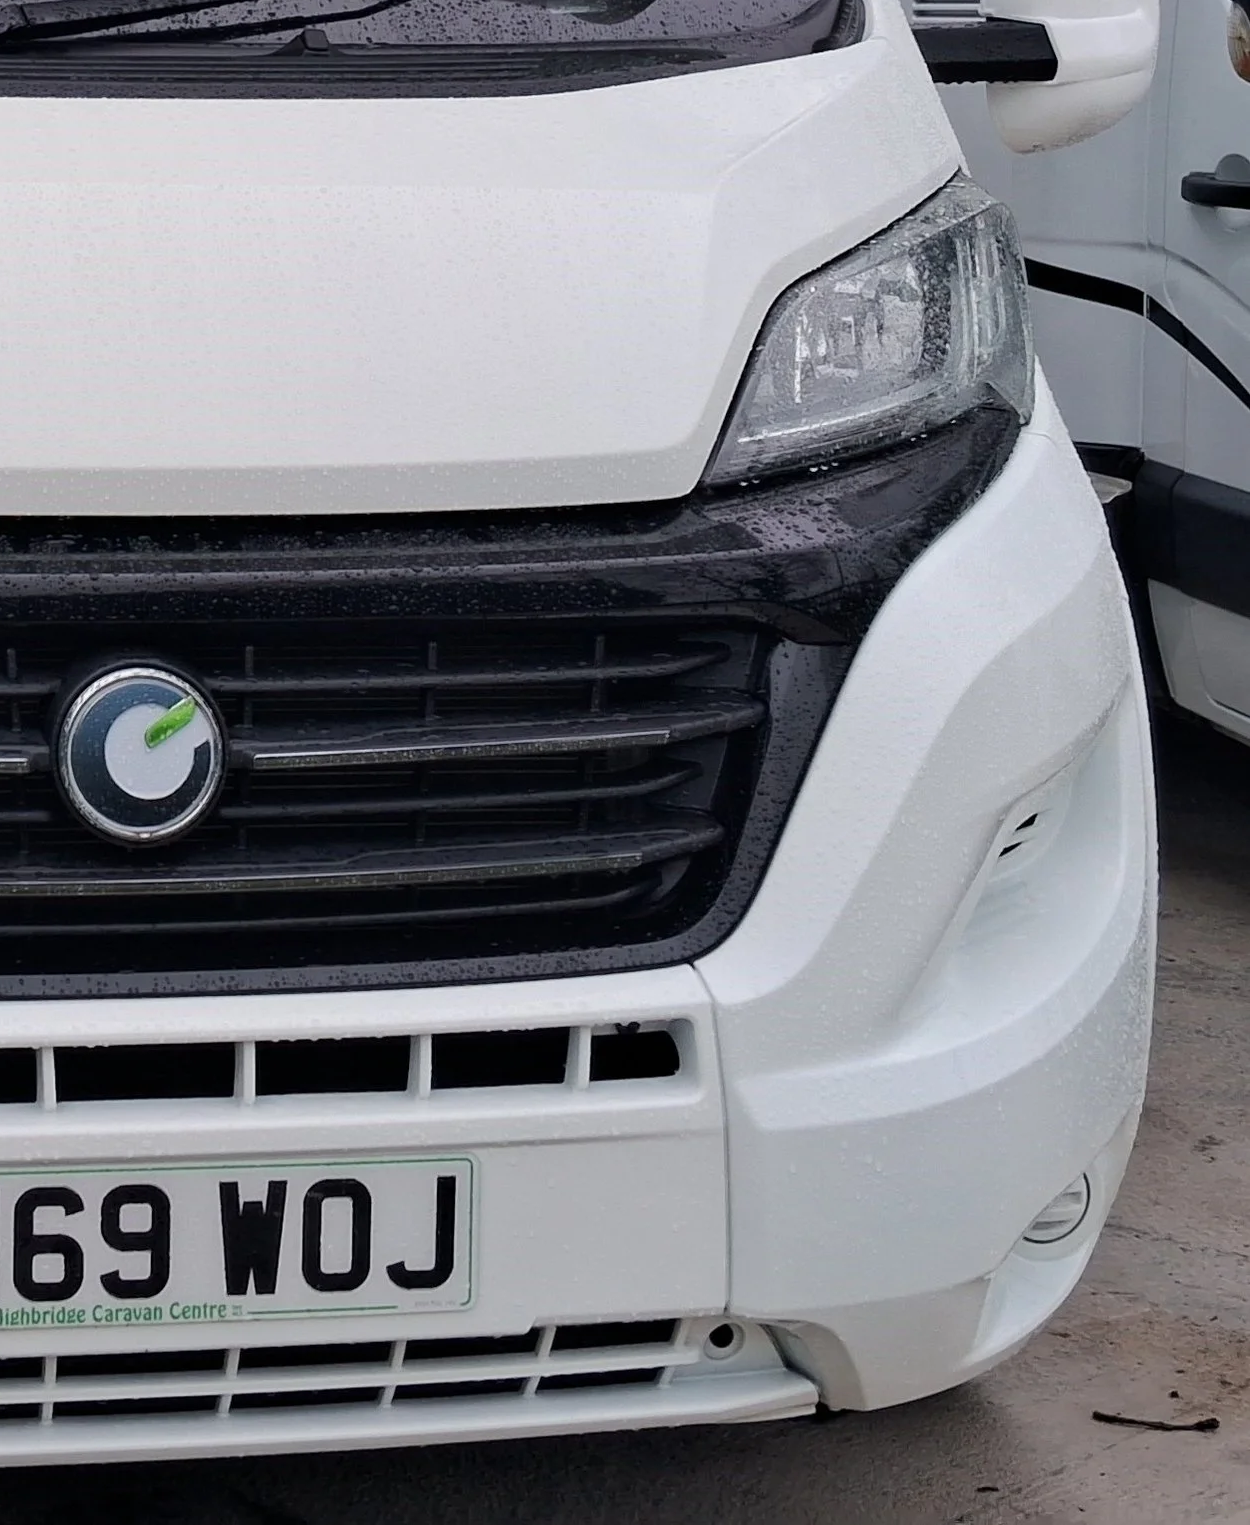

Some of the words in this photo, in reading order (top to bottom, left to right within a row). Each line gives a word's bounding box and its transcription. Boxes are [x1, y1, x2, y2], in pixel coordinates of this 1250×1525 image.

[219, 1175, 457, 1297] WOJ
[92, 1305, 164, 1324] Caravan
[169, 1302, 227, 1320] Centre
